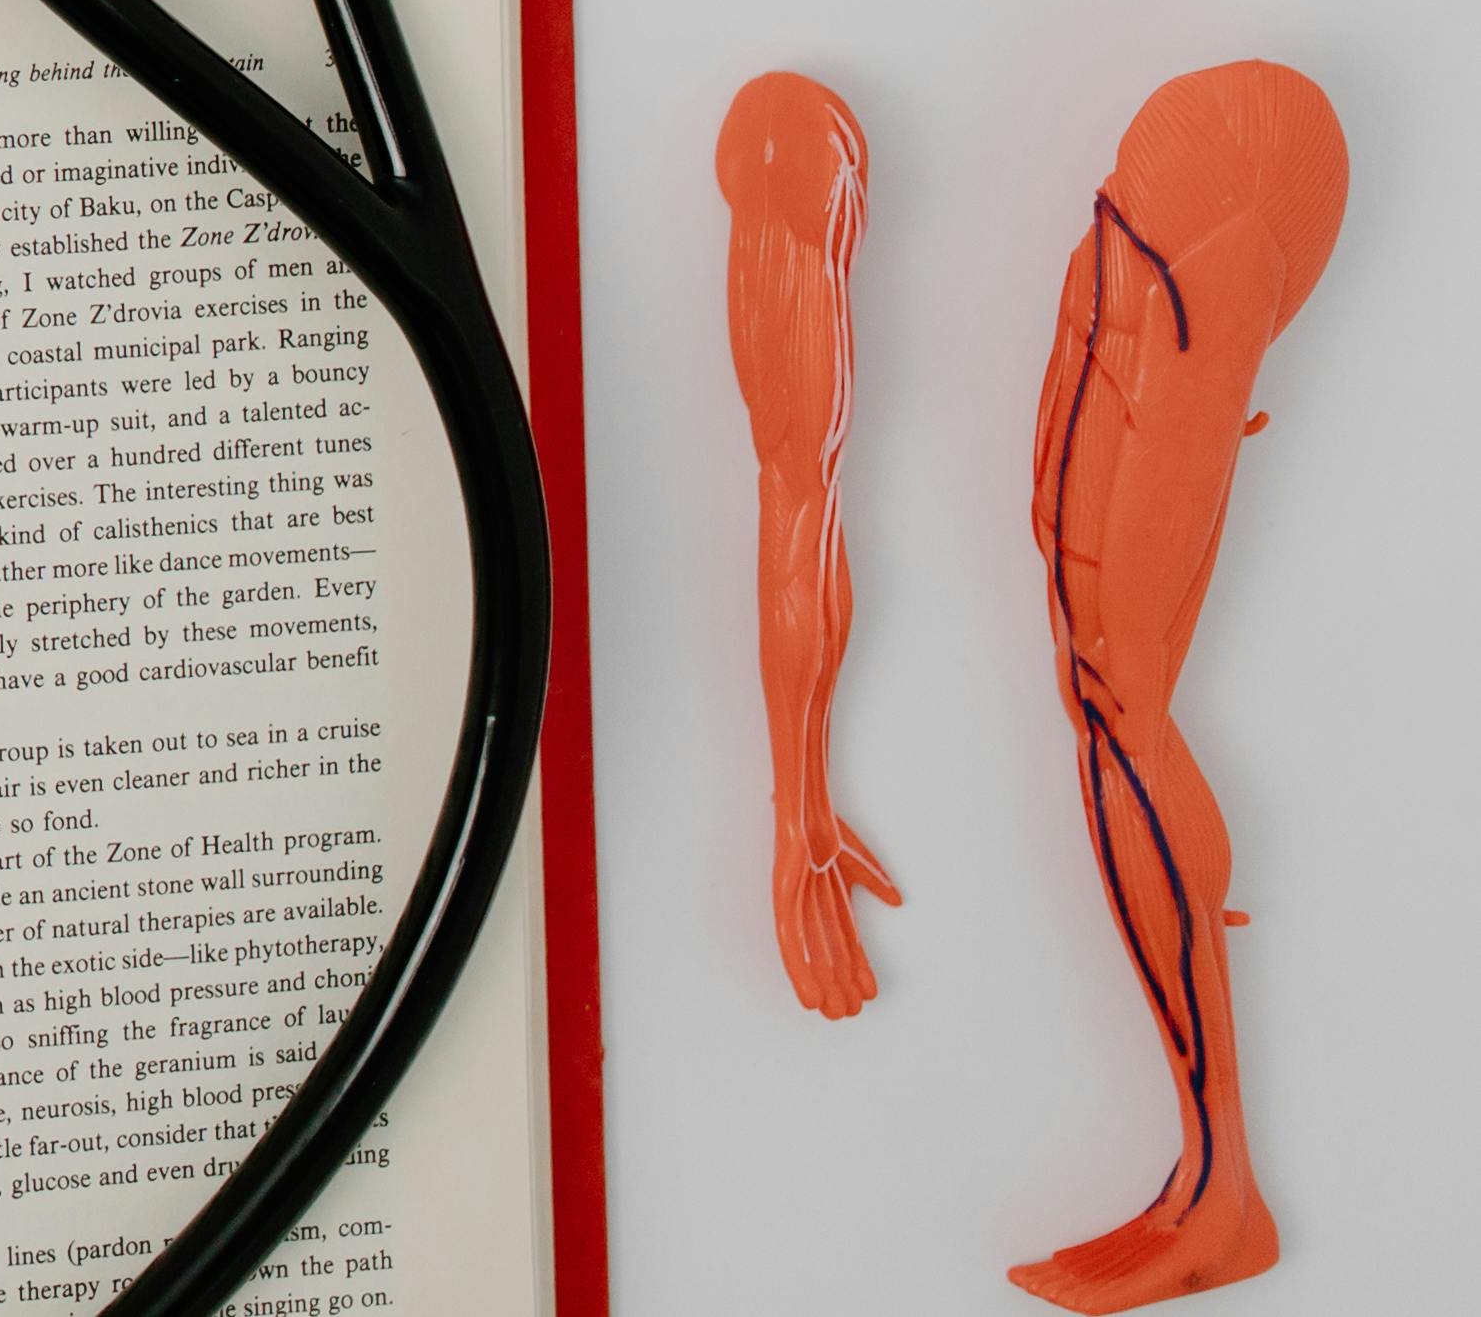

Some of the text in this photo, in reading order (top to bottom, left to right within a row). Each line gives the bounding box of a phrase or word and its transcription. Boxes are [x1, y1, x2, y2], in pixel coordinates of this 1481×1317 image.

[28, 59, 96, 83] behind
[63, 123, 114, 147] than
[125, 115, 204, 146] willing
